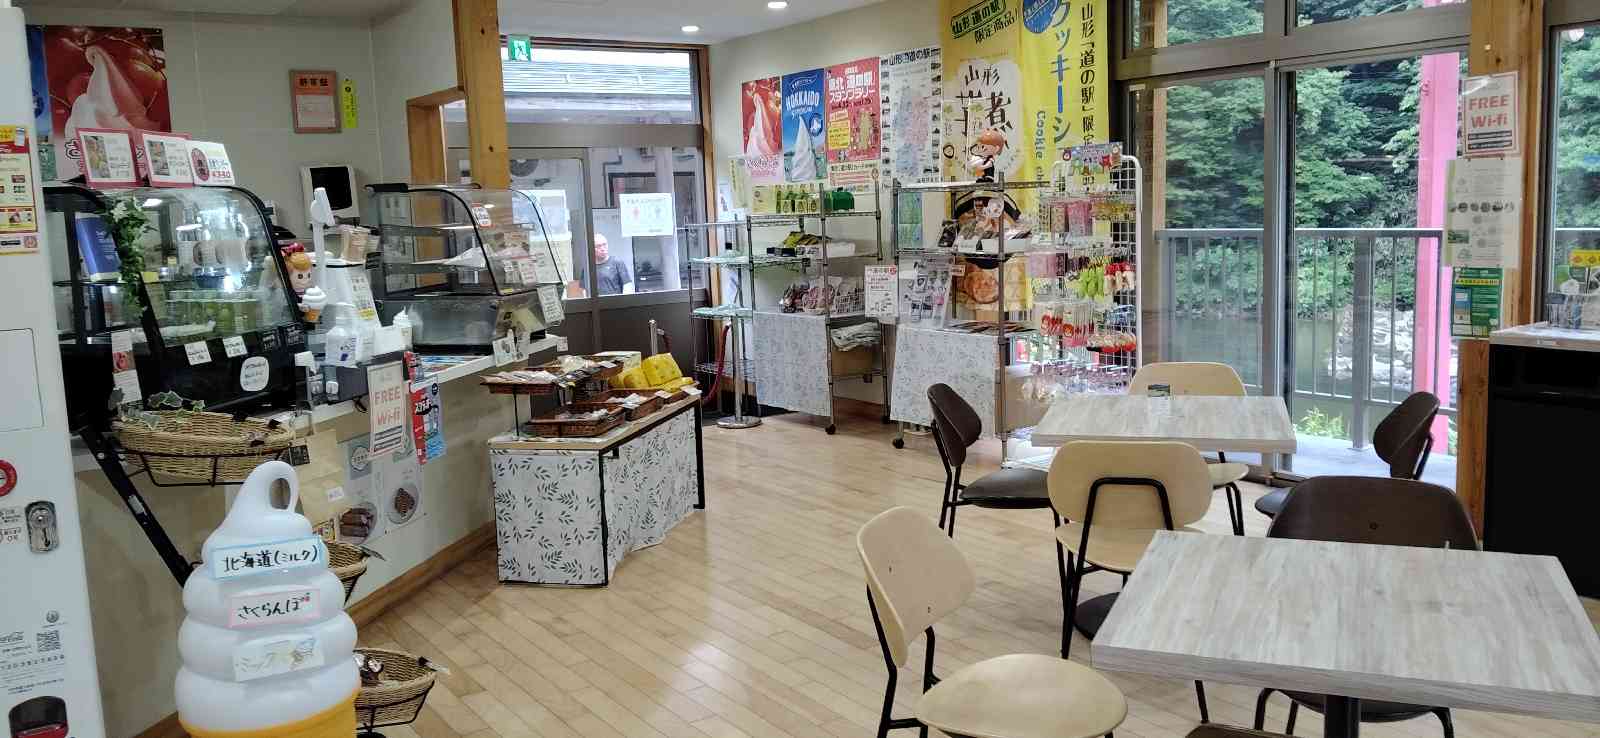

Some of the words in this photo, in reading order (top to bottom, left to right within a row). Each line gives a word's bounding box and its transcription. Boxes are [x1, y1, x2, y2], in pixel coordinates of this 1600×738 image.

[964, 64, 1000, 86] 山形
[786, 90, 820, 111] HOKKAIDO
[1469, 95, 1510, 110] FREE
[375, 386, 402, 406] FREE
[238, 597, 304, 620] さくらんぼ
